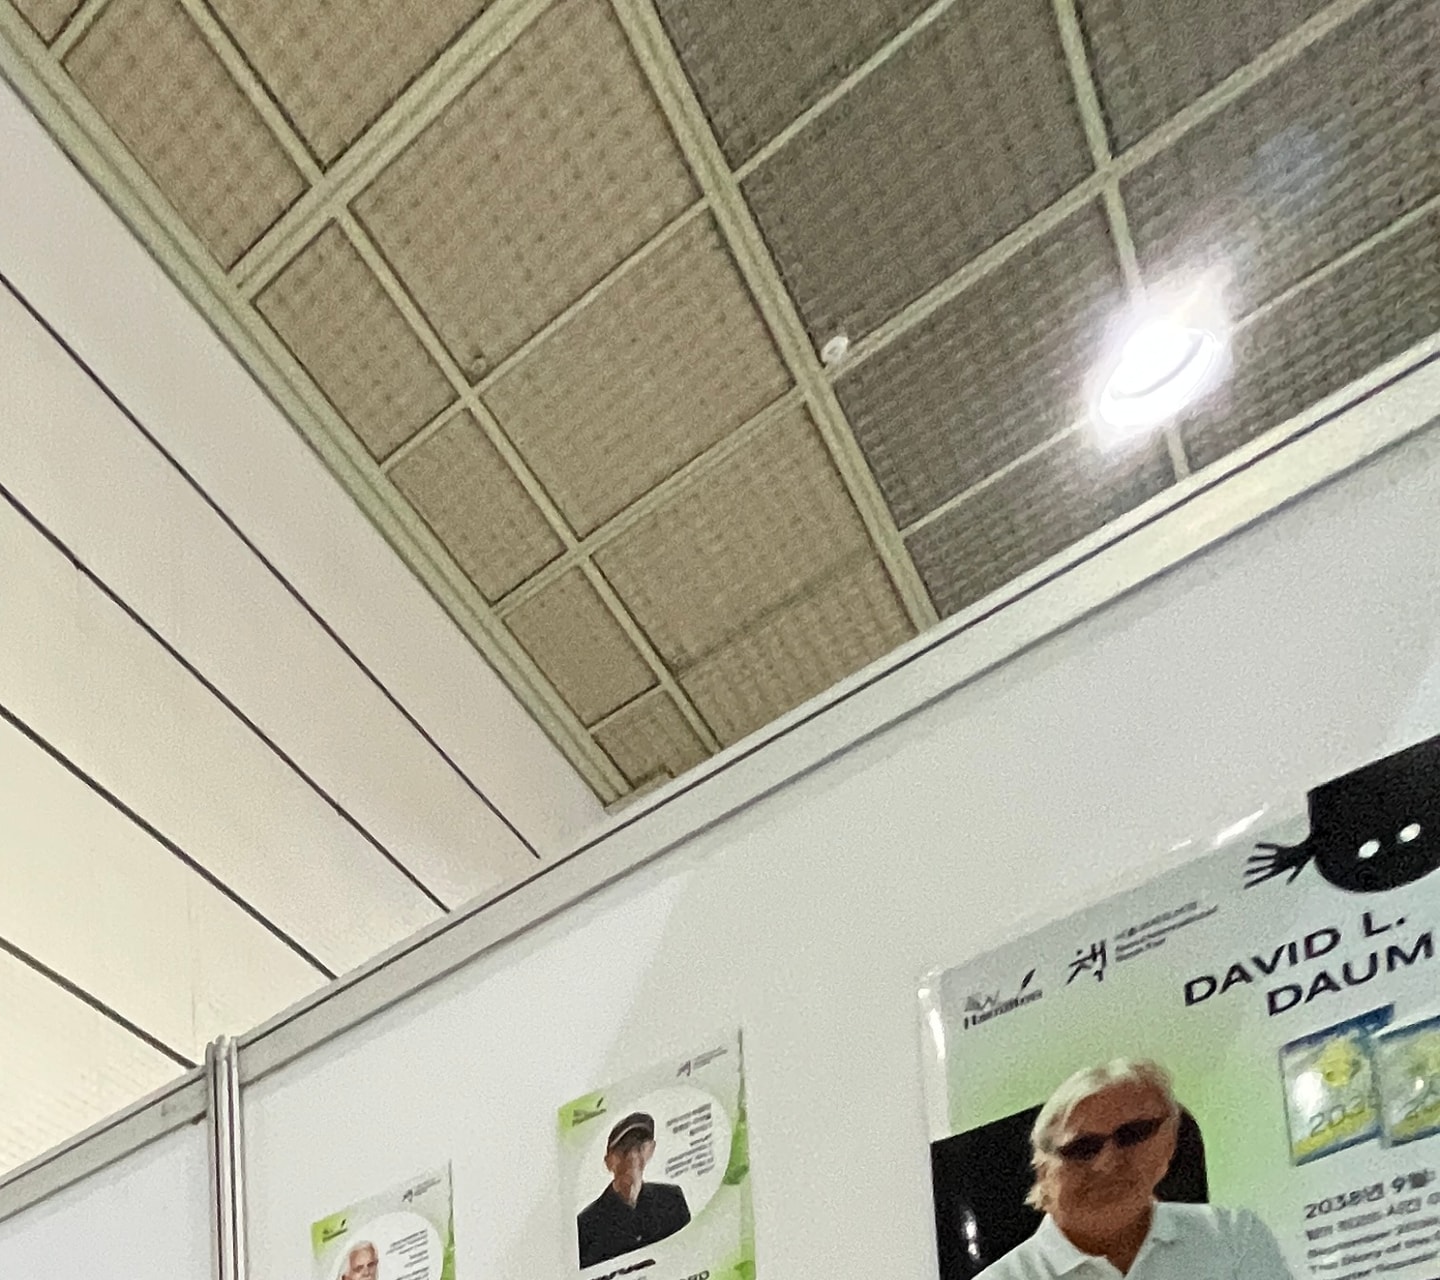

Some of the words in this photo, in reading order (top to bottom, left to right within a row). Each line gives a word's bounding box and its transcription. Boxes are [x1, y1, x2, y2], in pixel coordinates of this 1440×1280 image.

[1184, 926, 1342, 1007] DAVID
[1362, 911, 1406, 938] L.
[1267, 930, 1435, 1017] DAUM
